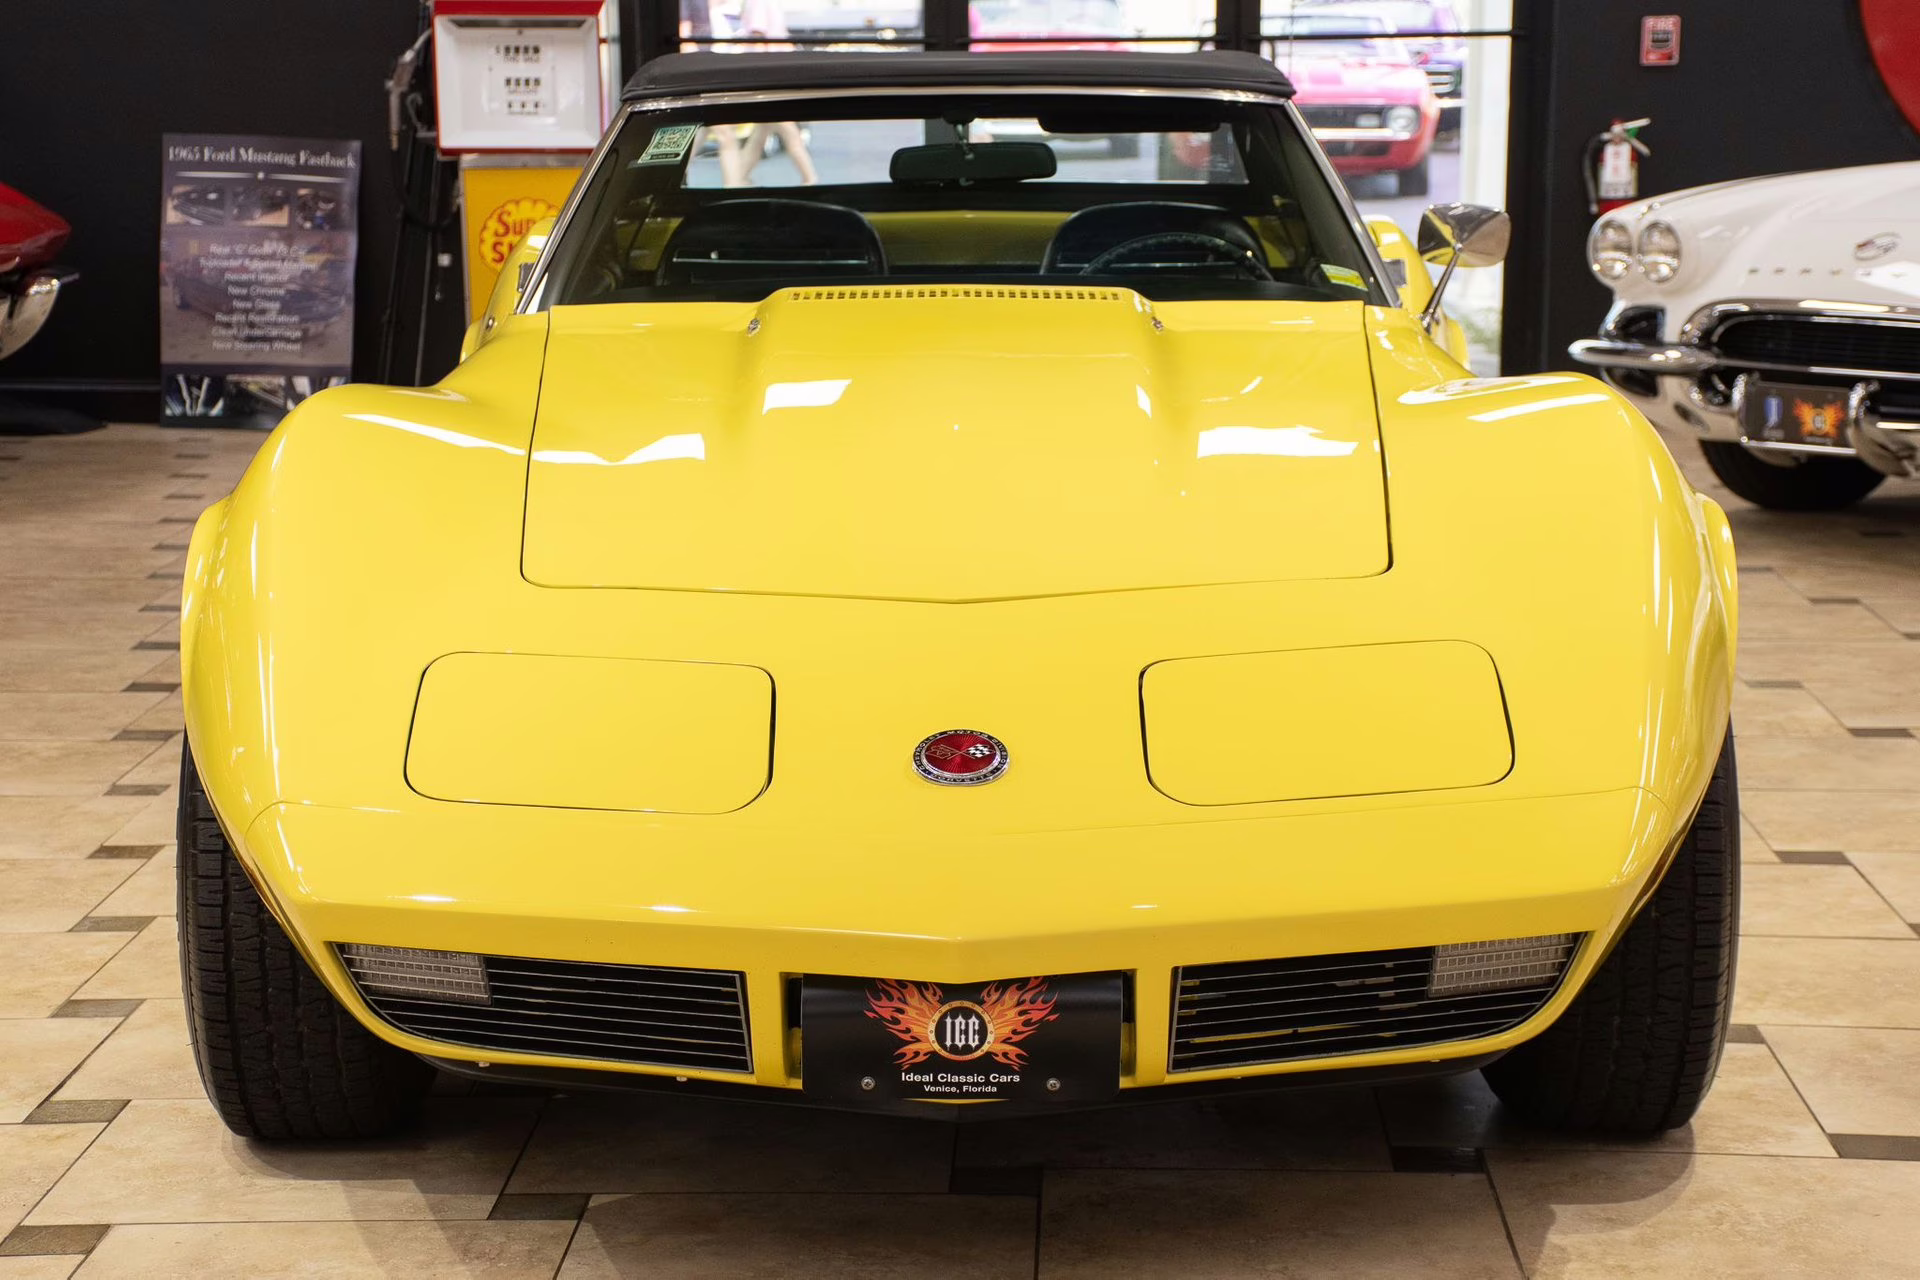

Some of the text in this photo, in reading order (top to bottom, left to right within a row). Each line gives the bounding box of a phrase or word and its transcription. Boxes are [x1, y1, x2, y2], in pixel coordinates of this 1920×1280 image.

[168, 146, 357, 169] 1965 Ford Mustang Fastback
[227, 285, 286, 296] New Chrome
[232, 299, 252, 309] New
[211, 340, 233, 350] New
[901, 1072, 1021, 1084] Ideal Classic Cars
[923, 1084, 998, 1094] Venice, Florida
